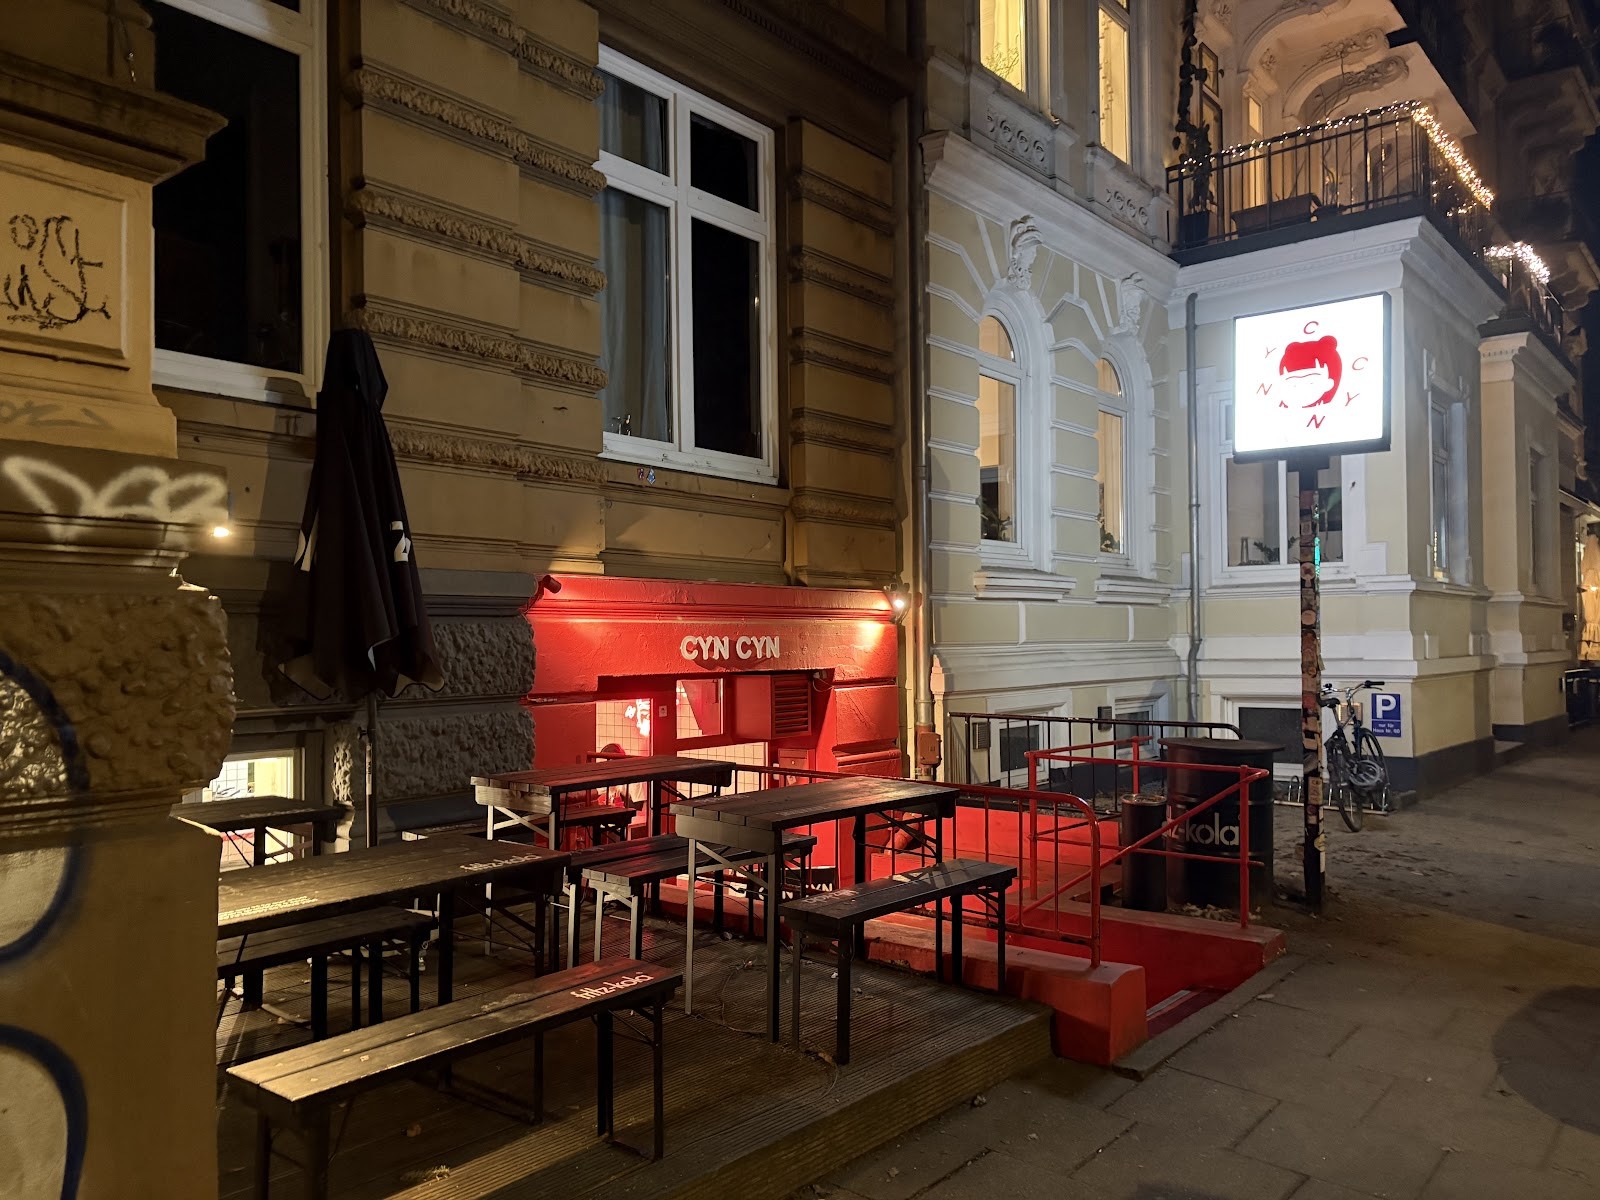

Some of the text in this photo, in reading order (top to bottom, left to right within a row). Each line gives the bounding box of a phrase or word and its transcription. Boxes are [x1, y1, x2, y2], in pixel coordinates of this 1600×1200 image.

[1303, 320, 1319, 335] C
[1265, 347, 1277, 359] Y
[1351, 356, 1369, 371] C
[1256, 382, 1273, 396] N
[1344, 391, 1361, 407] Y
[1306, 414, 1326, 429] N
[680, 635, 780, 660] CYN CYN
[1376, 695, 1396, 718] P
[570, 974, 655, 1000] fritz-kola
